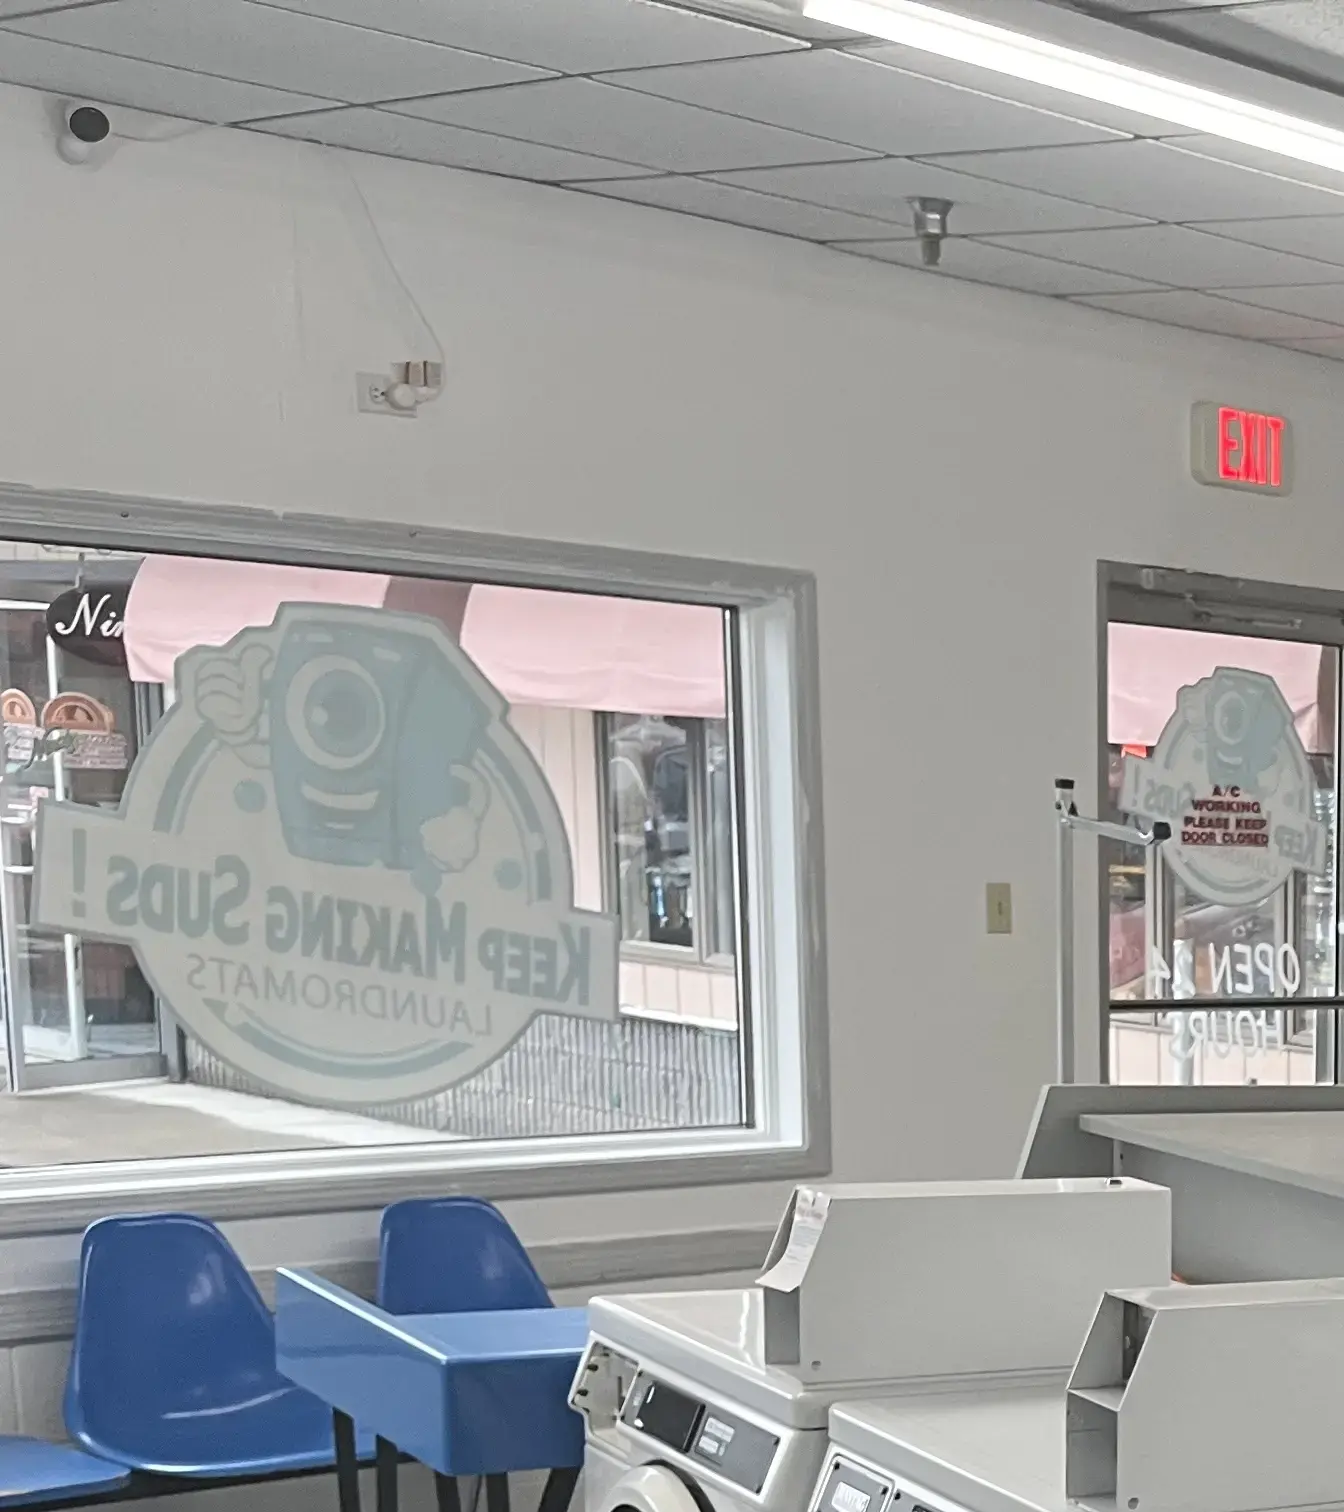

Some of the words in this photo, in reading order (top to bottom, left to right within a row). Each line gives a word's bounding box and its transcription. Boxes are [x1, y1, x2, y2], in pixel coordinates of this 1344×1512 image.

[1218, 407, 1284, 487] EXIT
[1212, 785, 1241, 798] A/C
[1192, 799, 1261, 813] WORKING
[1184, 815, 1230, 830] PLEASE
[1235, 817, 1267, 831] KEEP
[1182, 831, 1217, 845] DOOR
[1222, 832, 1269, 847] CLOSED
